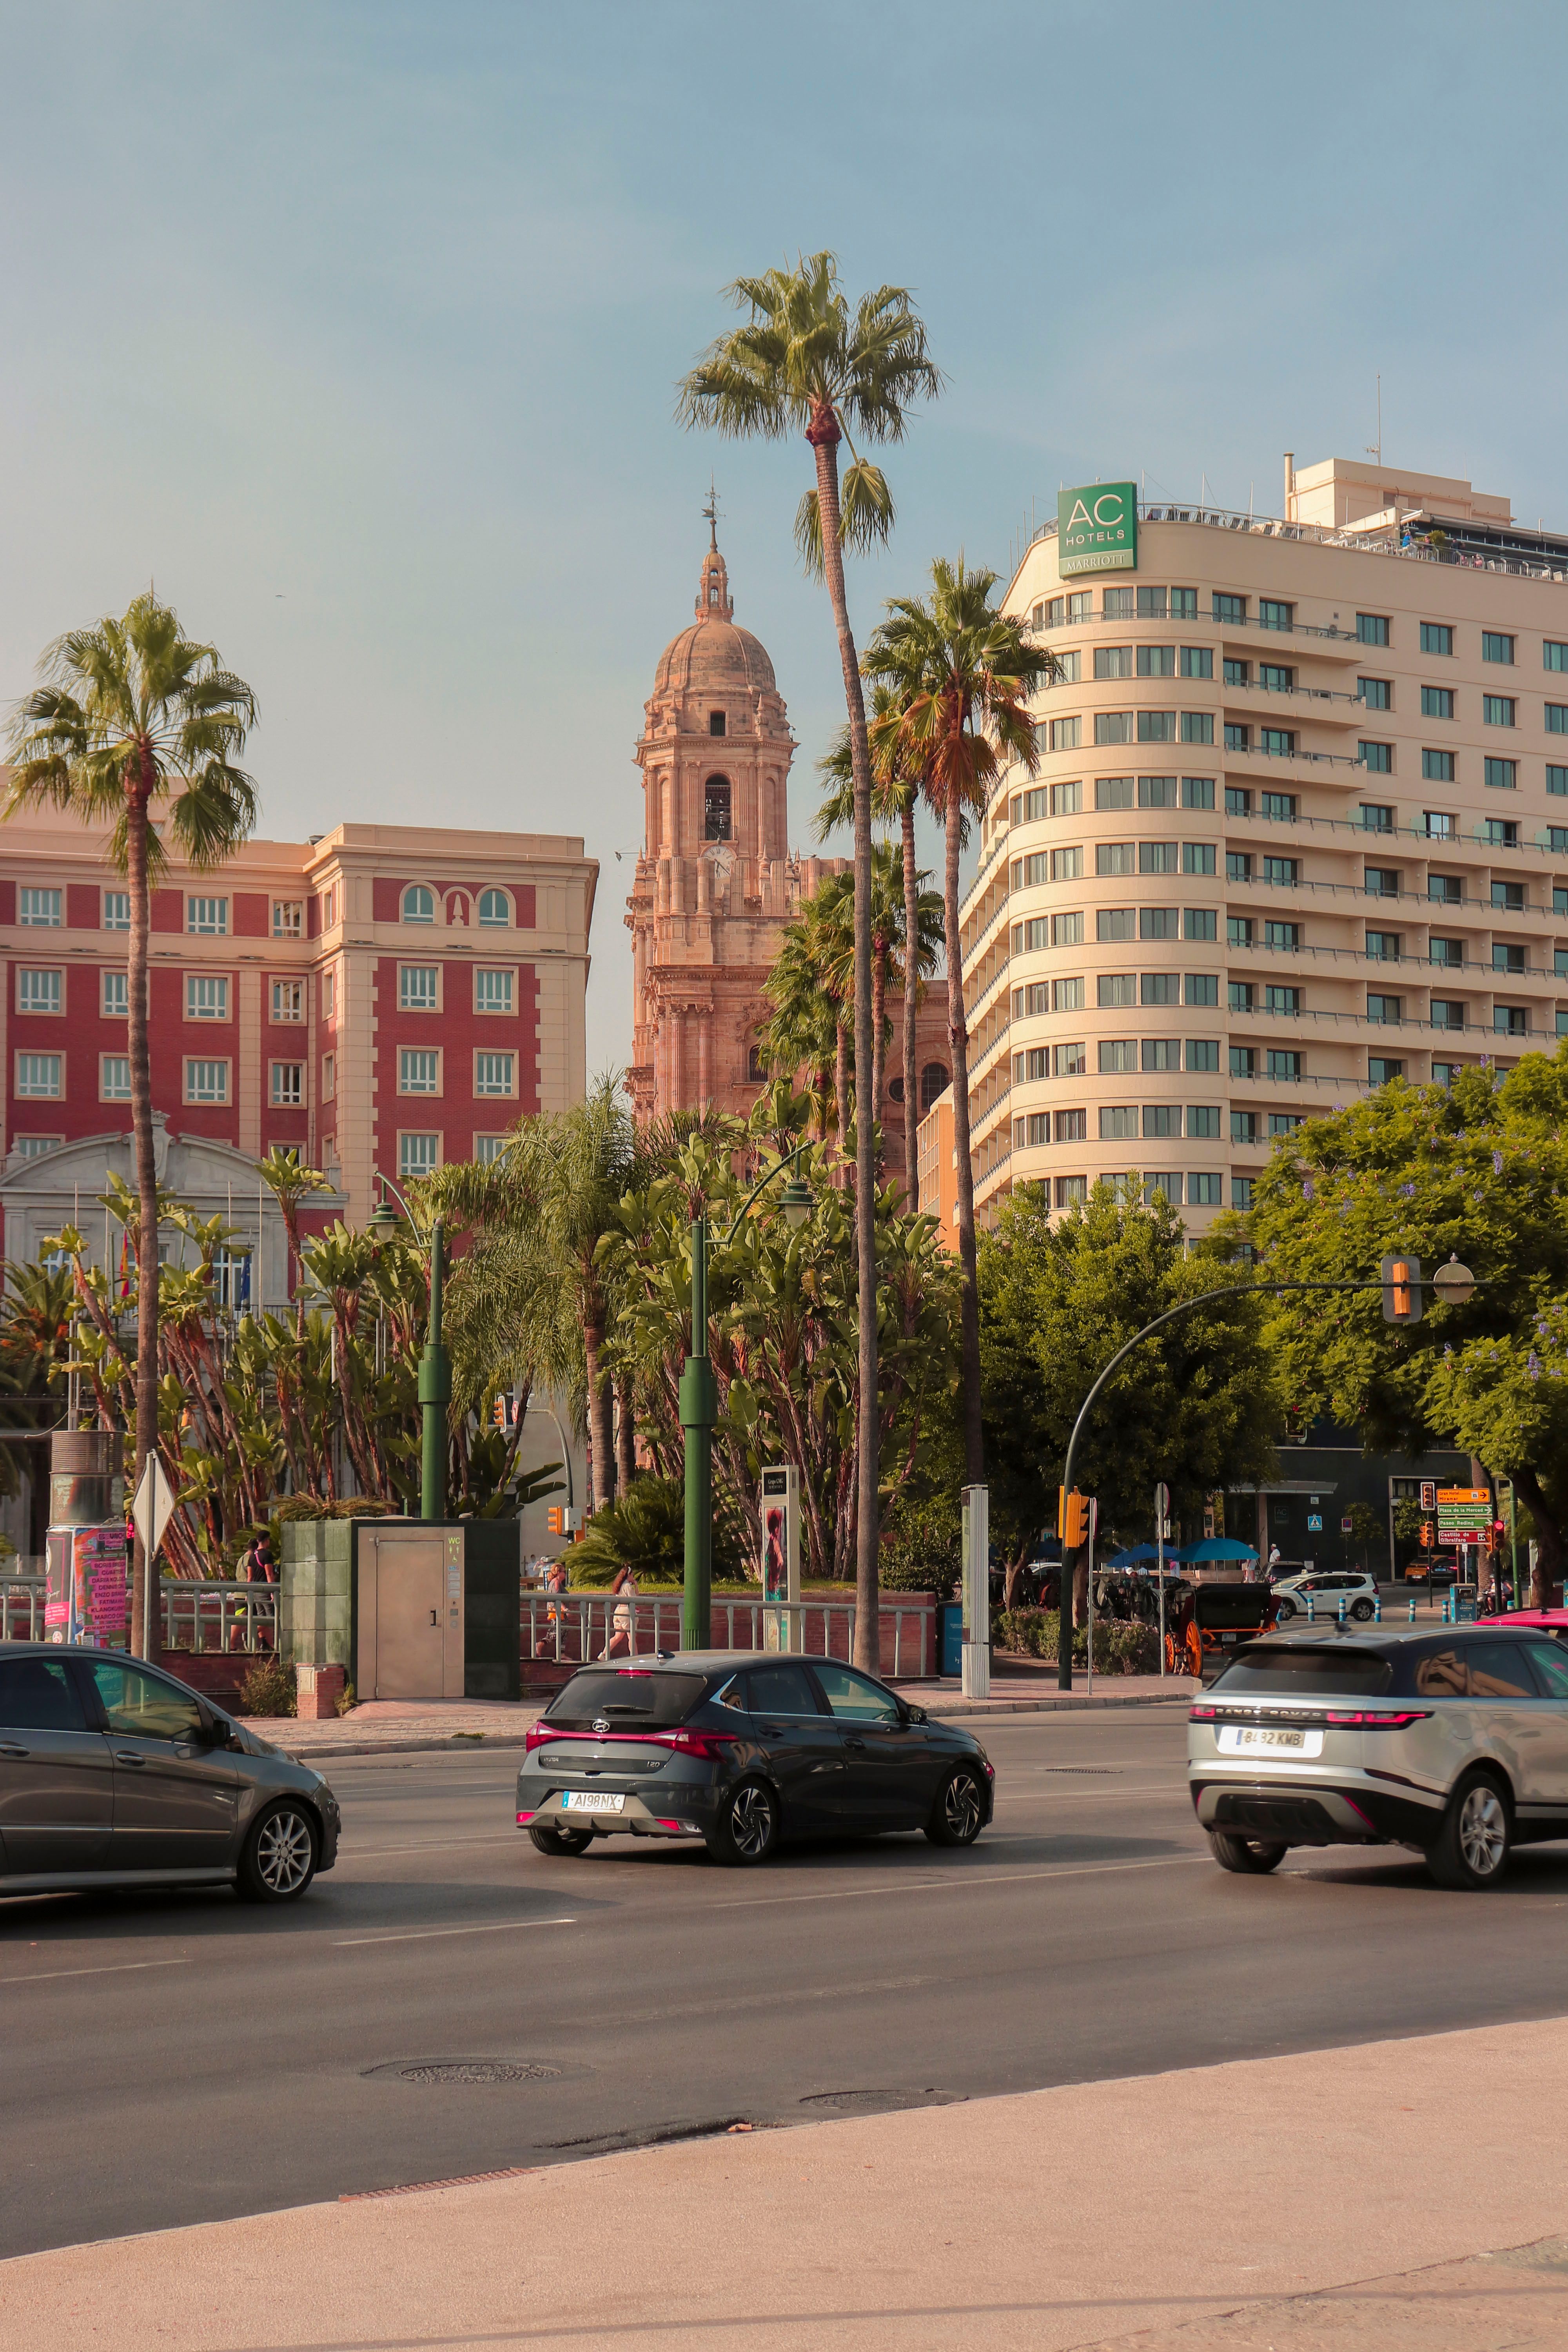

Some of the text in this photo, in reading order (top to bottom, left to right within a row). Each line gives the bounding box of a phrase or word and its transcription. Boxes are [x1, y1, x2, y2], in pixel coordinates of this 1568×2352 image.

[1066, 494, 1124, 531] AC
[1066, 530, 1125, 546] HOTELS
[1067, 554, 1125, 571] MARRIOTT
